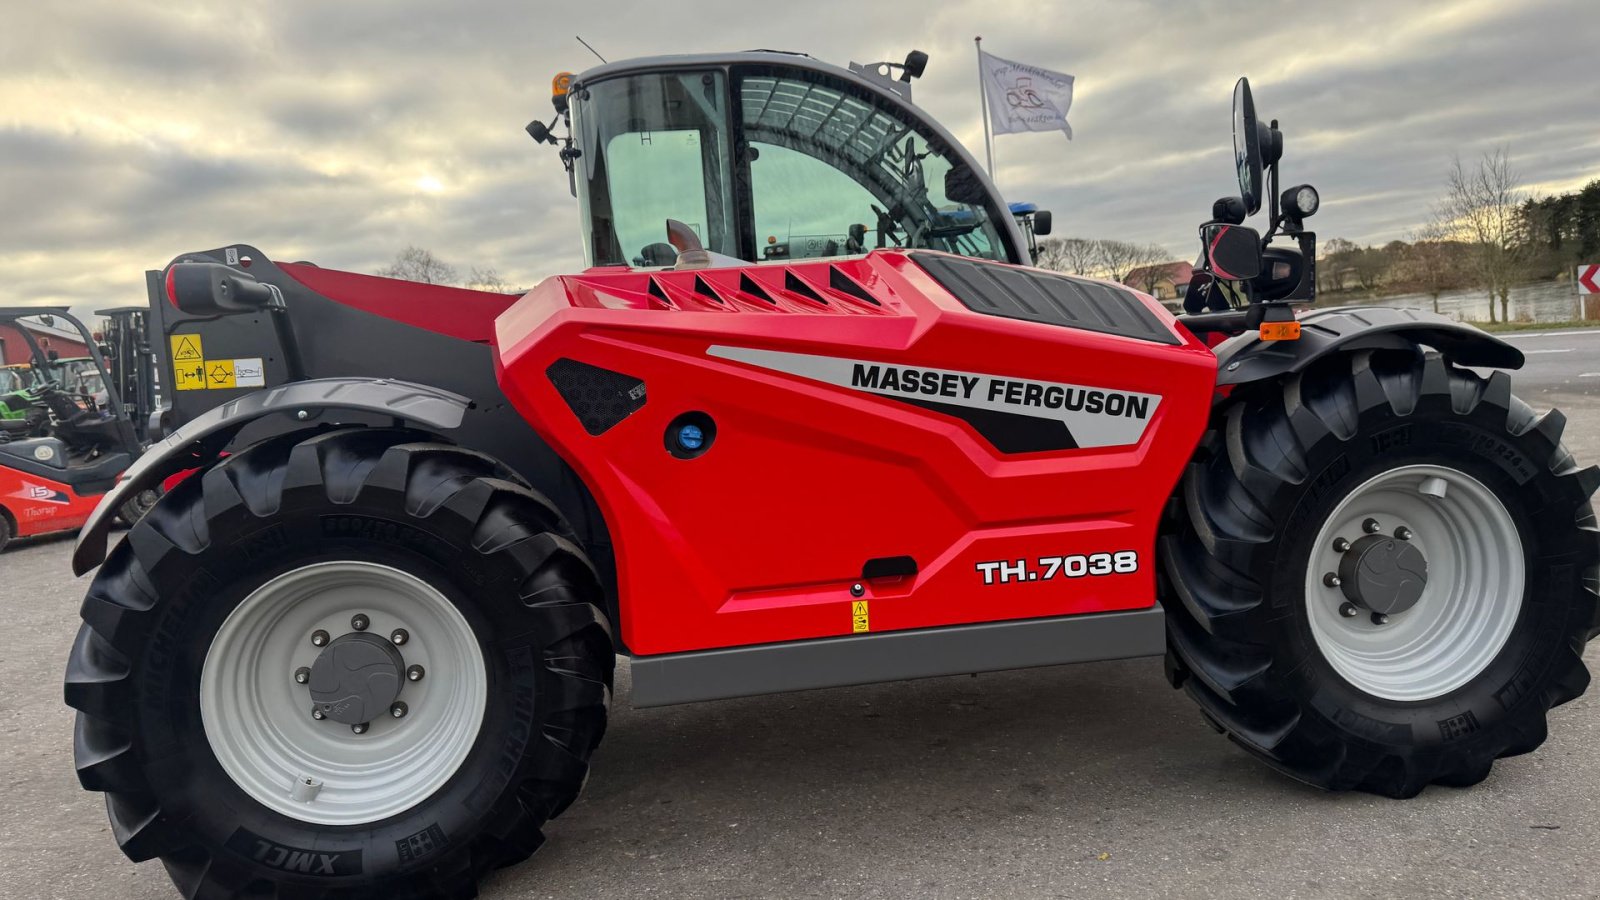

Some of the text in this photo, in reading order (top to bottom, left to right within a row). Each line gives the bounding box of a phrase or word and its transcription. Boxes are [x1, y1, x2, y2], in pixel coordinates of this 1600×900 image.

[852, 364, 1150, 420] MASSEY FERGUSON
[975, 549, 1139, 585] TH.7038
[254, 837, 342, 876] XMCL
